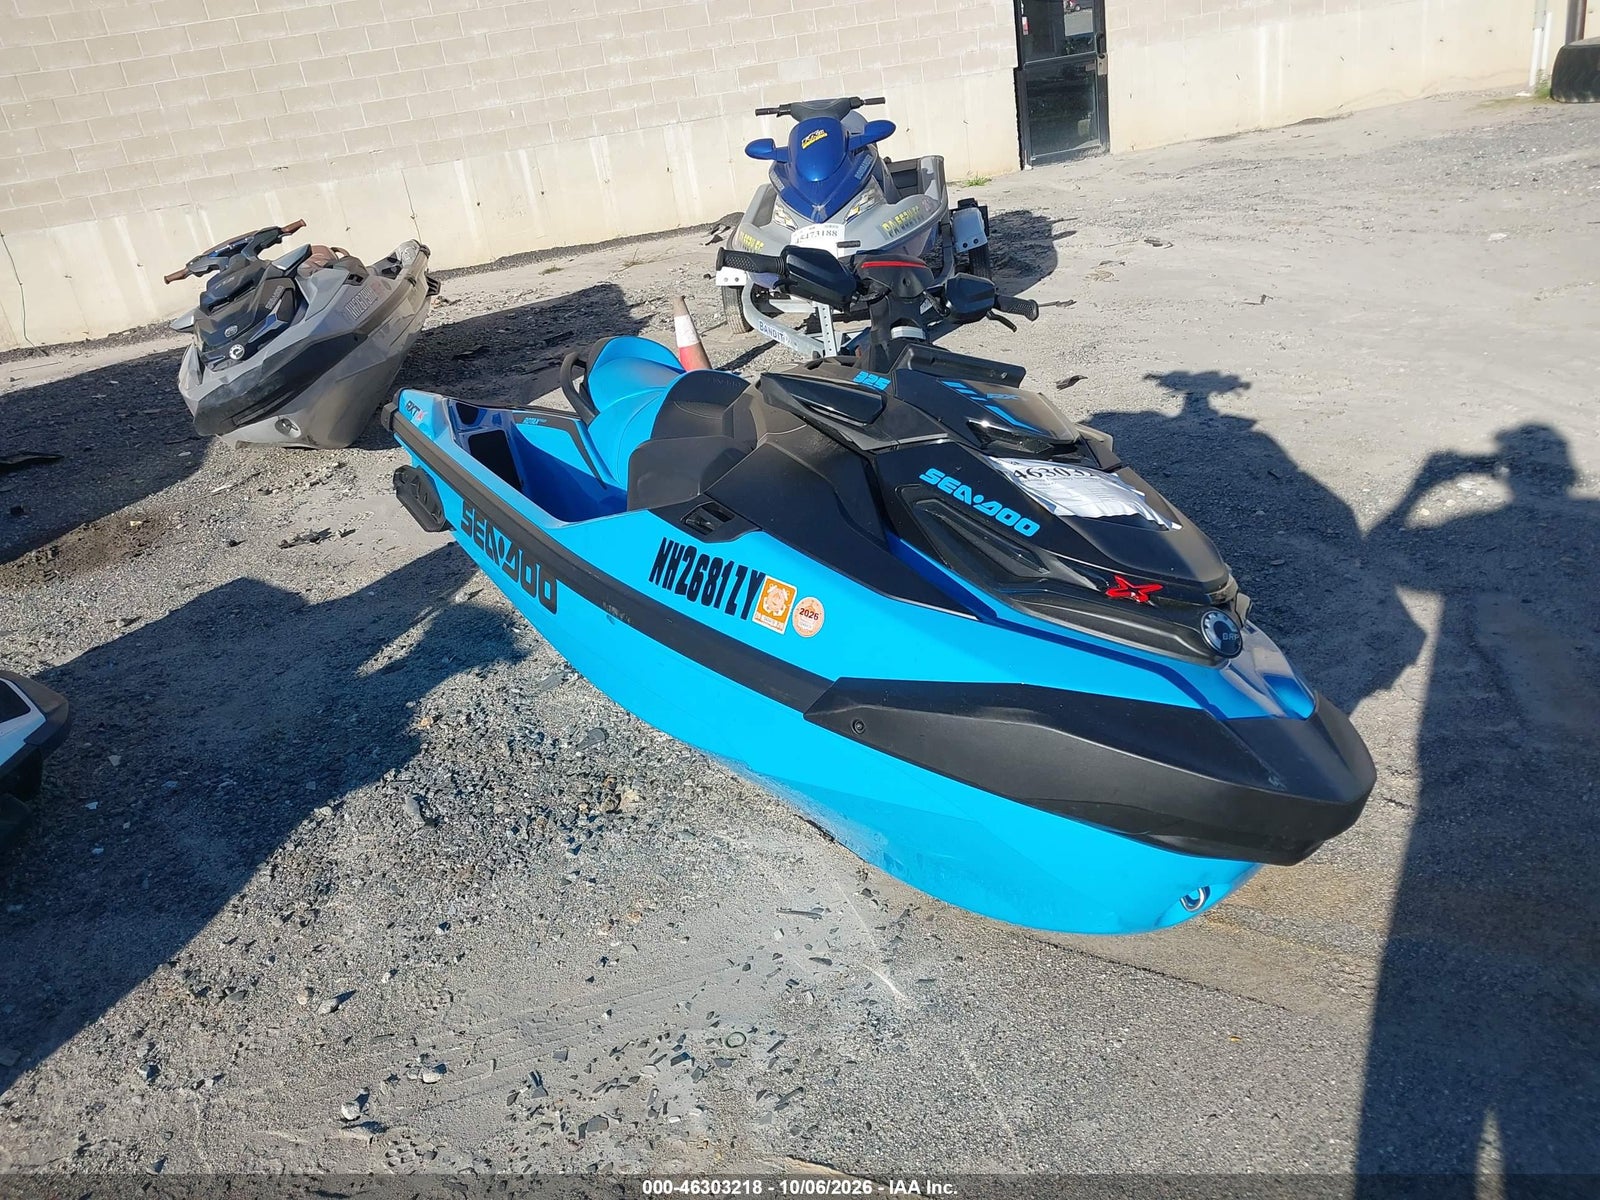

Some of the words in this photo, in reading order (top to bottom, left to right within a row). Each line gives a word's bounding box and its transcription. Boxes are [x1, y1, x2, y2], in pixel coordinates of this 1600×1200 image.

[759, 320, 784, 340] BANDIT
[853, 370, 891, 391] 325
[648, 536, 767, 621] NH2681ZY
[799, 607, 820, 621] 2026
